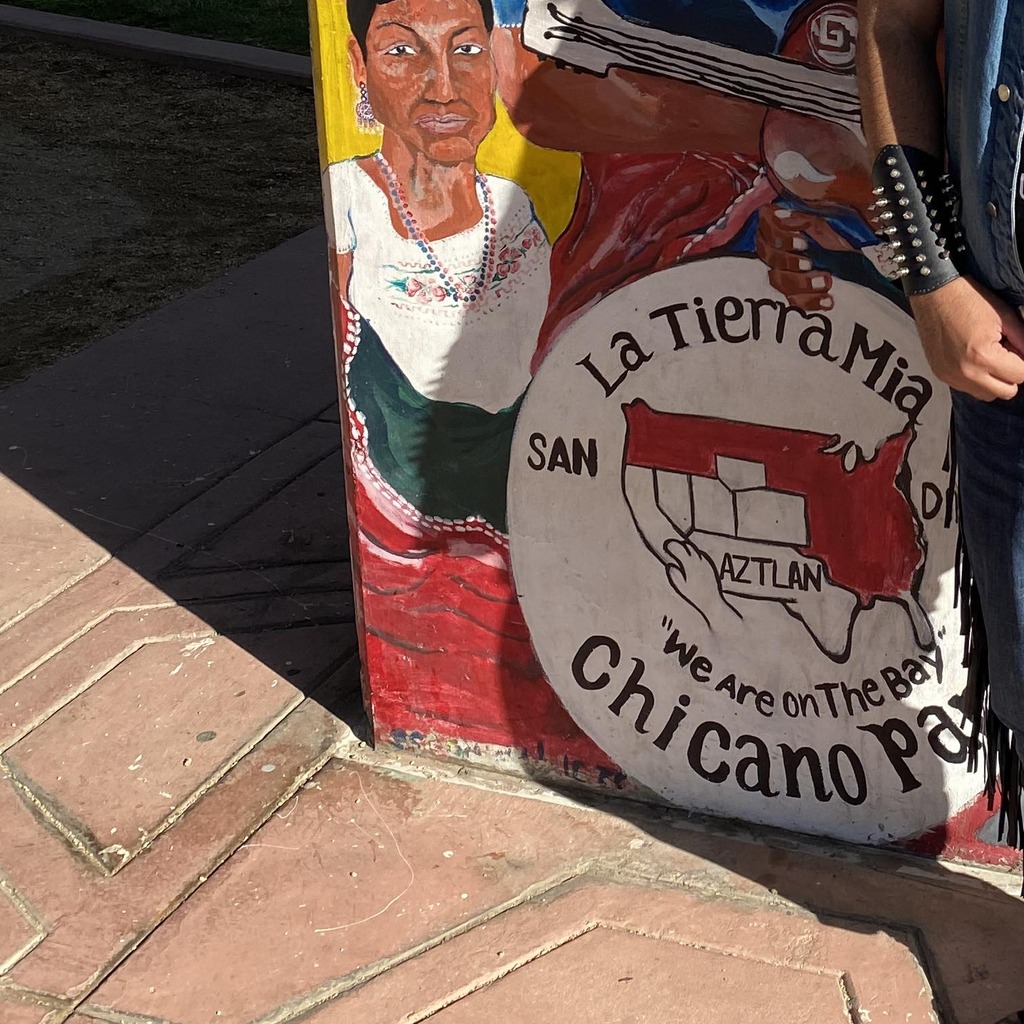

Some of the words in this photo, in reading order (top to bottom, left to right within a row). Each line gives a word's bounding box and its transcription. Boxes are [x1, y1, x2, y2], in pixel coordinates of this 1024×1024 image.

[575, 331, 654, 398] La
[649, 296, 839, 361] Tierra
[839, 322, 933, 426] Mia
[527, 433, 598, 476] SAN
[719, 553, 822, 592] AZTLAN
[715, 674, 774, 717] Are
[815, 678, 886, 719] The
[572, 635, 867, 805] Chicano
